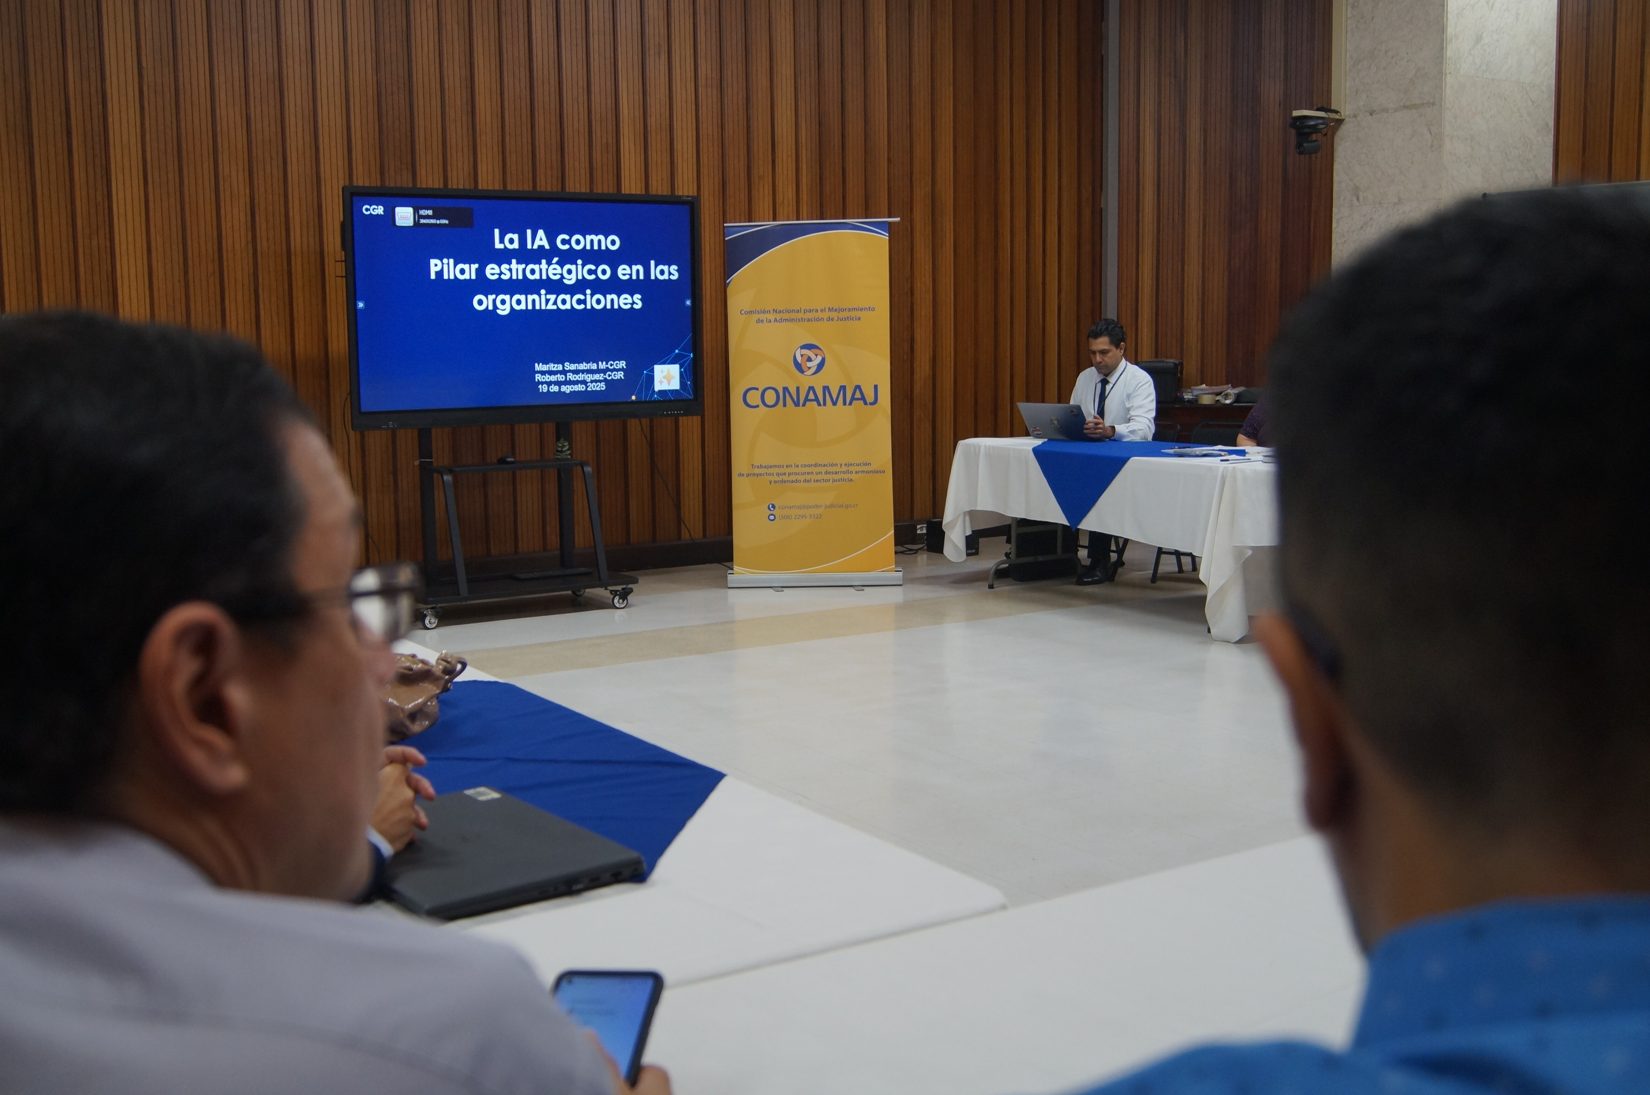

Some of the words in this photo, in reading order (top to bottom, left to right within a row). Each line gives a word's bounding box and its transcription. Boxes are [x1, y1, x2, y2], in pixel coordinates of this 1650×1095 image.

[362, 205, 385, 215] CGR
[494, 229, 519, 249] La
[526, 230, 550, 249] IA
[556, 234, 621, 250] como
[430, 259, 479, 280] Pilar
[485, 258, 611, 284] estratégico
[617, 263, 645, 280] en
[650, 260, 679, 280] las
[472, 289, 643, 315] organizaciones
[772, 307, 802, 315] Nacional
[828, 306, 875, 314] Mejoramiento
[535, 363, 563, 371] Maritza
[564, 362, 597, 370] Sanabria
[599, 361, 626, 369] M-CGR
[535, 373, 565, 382] Roberto
[538, 384, 548, 392] 19
[549, 383, 559, 392] de
[560, 384, 586, 393] agosto
[587, 382, 606, 390] 2025
[742, 384, 879, 409] CONAMAJ
[787, 471, 814, 479] procuren
